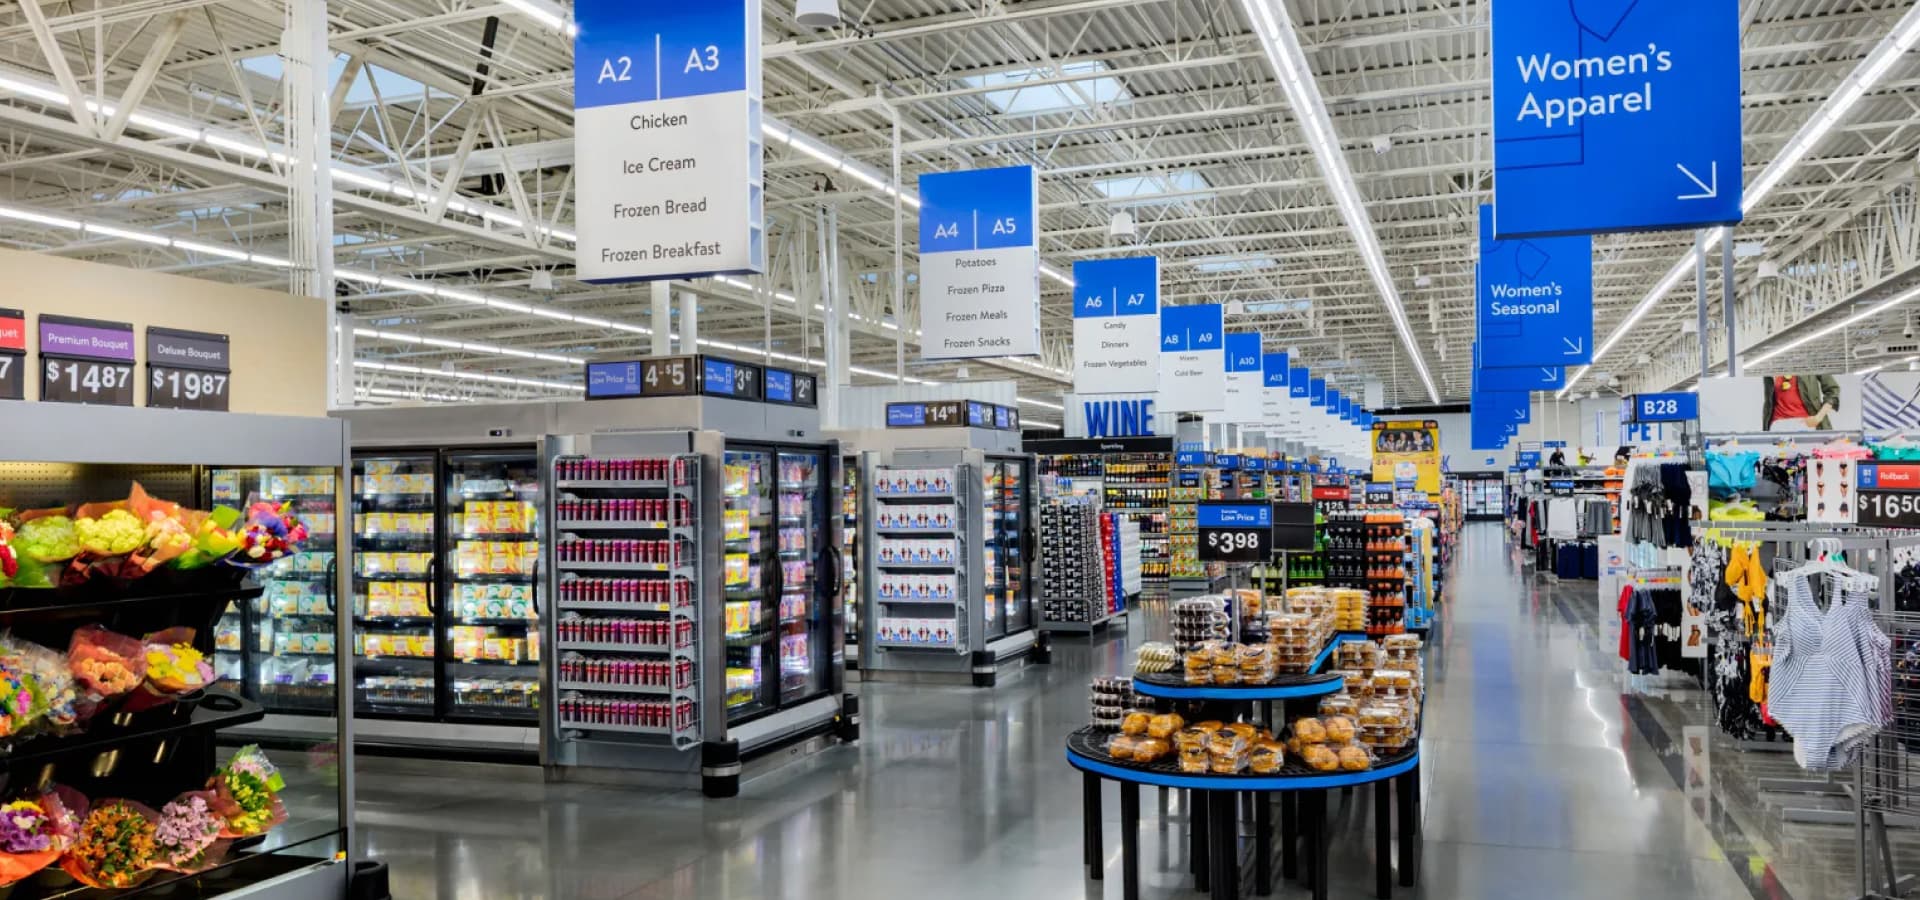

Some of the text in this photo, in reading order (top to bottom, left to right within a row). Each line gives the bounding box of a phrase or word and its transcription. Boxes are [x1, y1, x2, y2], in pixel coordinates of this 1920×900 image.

[683, 45, 720, 74] A3
[1516, 43, 1672, 84] Women's
[597, 56, 633, 84] A2
[1516, 82, 1652, 128] Apparel
[630, 112, 688, 130] Chicken
[623, 156, 696, 174] Ice Cream
[613, 197, 707, 219] Frozen Bread
[934, 223, 959, 240] A4
[992, 217, 1017, 235] A5
[601, 241, 721, 264] Frozen Breakfast
[955, 257, 997, 268] Potatoes
[947, 283, 1005, 295] Frozen Pizza
[1490, 281, 1562, 298] Women's
[1084, 295, 1102, 309] A6
[1127, 293, 1145, 306] A7
[946, 310, 1008, 322] Frozen Meals
[1491, 299, 1560, 317] Seasonal
[1103, 321, 1127, 331] Candy
[48, 332, 129, 350] Premium Bouquet
[944, 337, 1011, 348] Frozen Snacks
[1101, 340, 1129, 349] Dinners
[1164, 334, 1179, 345] A8
[1198, 332, 1213, 343] A9
[157, 343, 221, 361] Deluxe Bouquet
[1083, 359, 1147, 369] Frozen Vegetables
[1238, 356, 1255, 366] A10
[606, 375, 625, 384] Price
[1174, 369, 1203, 377] Cold Beer
[1643, 399, 1678, 415] B28
[1083, 399, 1155, 438] WINE
[1880, 471, 1910, 480] Rollback
[1221, 513, 1255, 521] Low Price
[1208, 532, 1259, 554] $398
